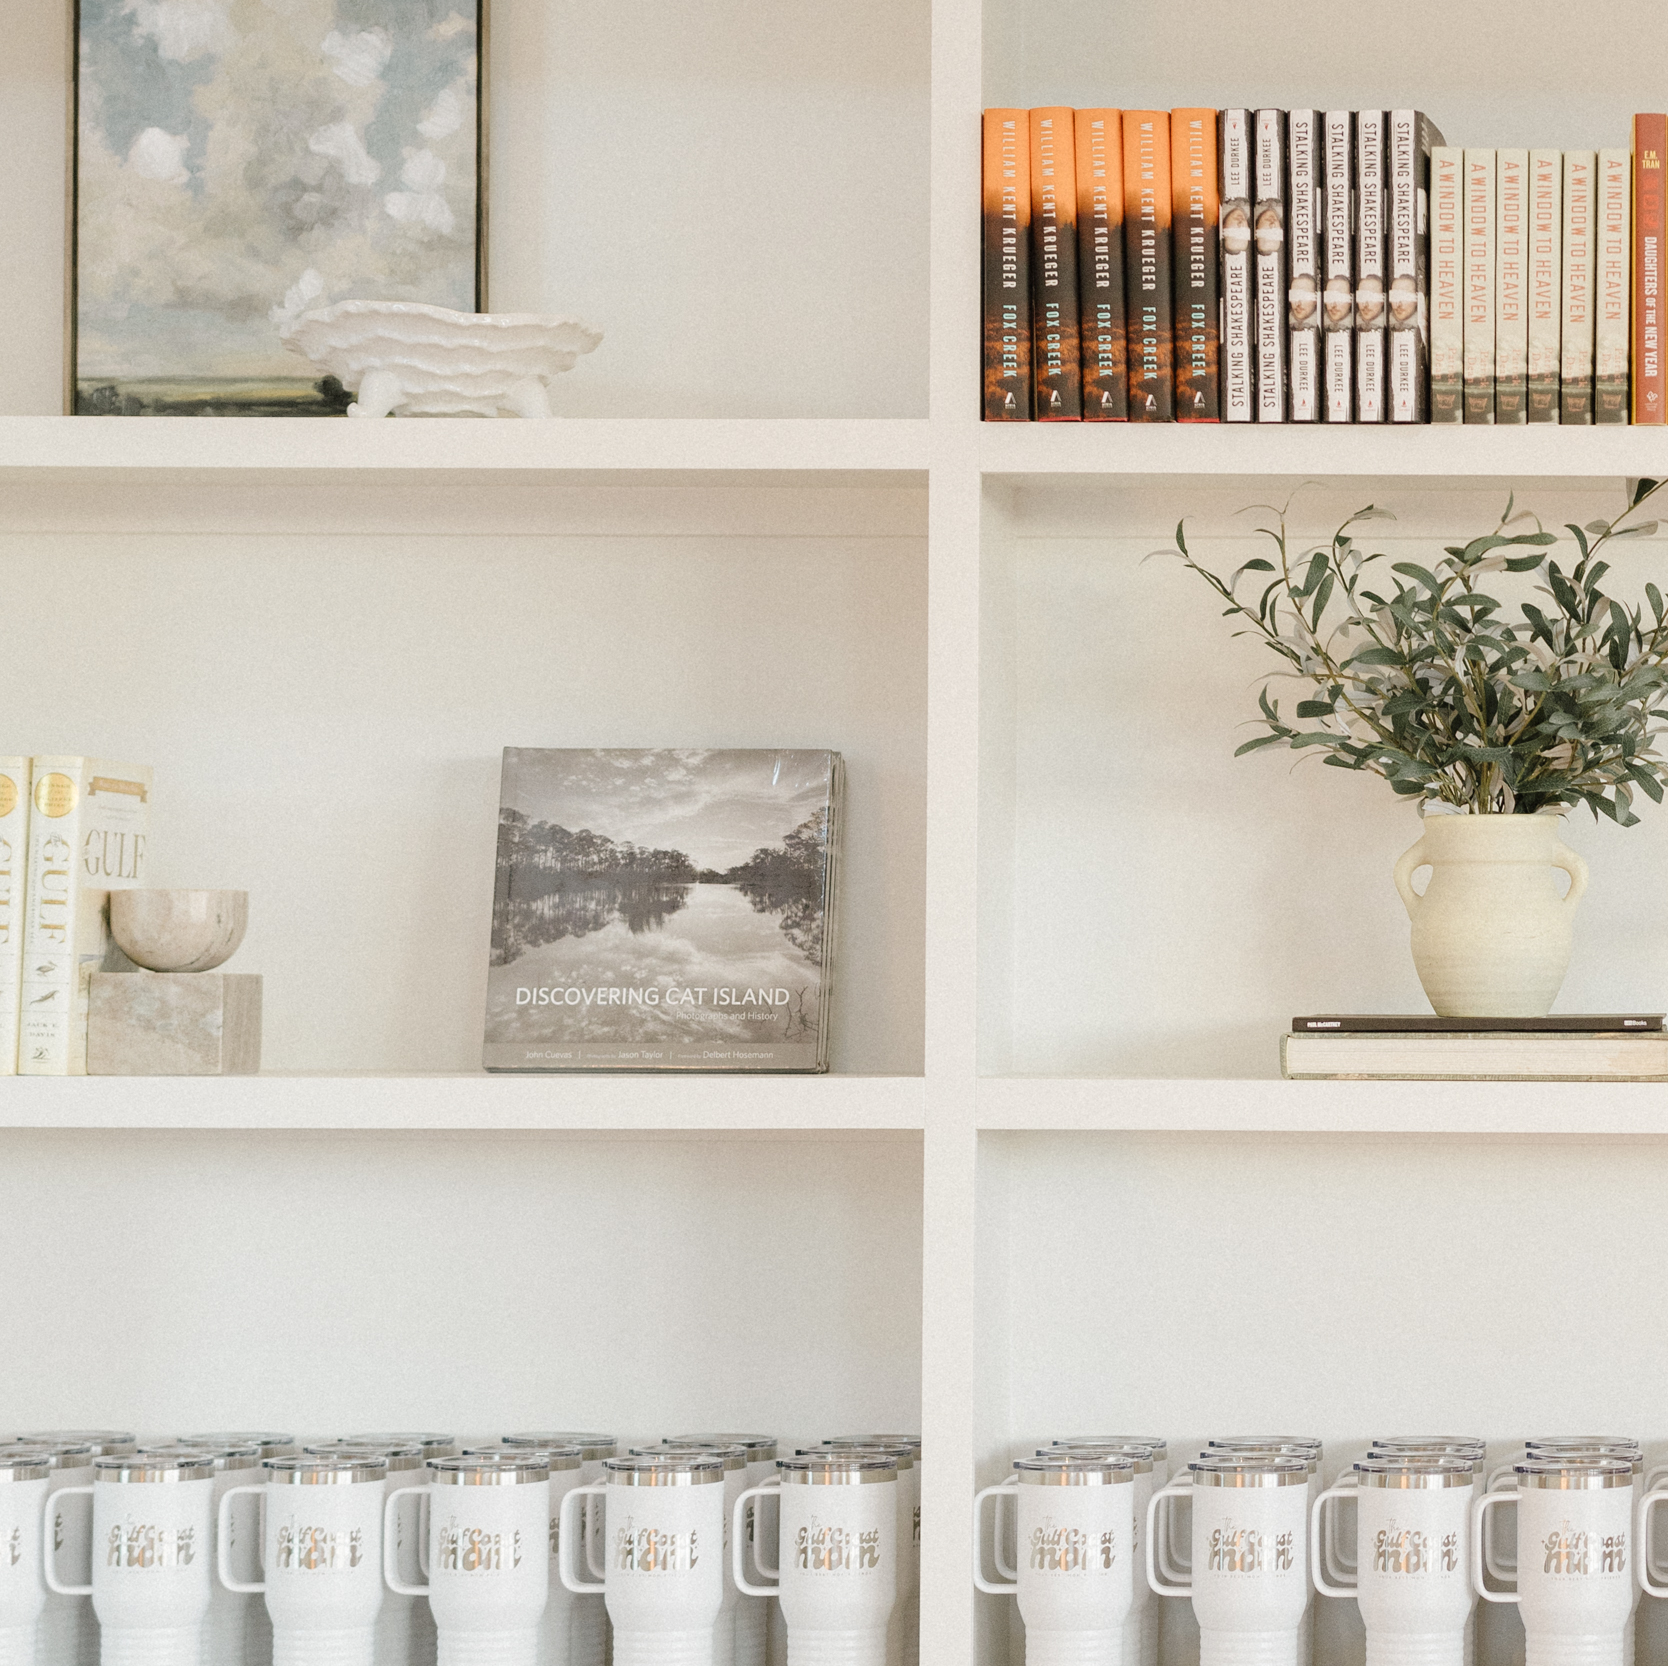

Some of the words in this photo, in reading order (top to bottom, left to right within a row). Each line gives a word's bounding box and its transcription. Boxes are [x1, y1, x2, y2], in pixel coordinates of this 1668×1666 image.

[1002, 120, 1015, 177] WILLIAM
[1295, 121, 1308, 177] STALKING
[1644, 150, 1657, 159] E.M.
[1439, 160, 1454, 169] A
[1642, 159, 1660, 169] TRAN
[1003, 186, 1016, 220] KENT
[1439, 173, 1455, 232] WINDOW
[1296, 183, 1309, 264] SHAKESPEARE
[1002, 227, 1016, 288] KRUEGER
[1438, 238, 1454, 254] TO
[1644, 237, 1657, 296] DAUGHTERS
[1438, 259, 1454, 320] HEAVEN
[1645, 298, 1655, 307] OF
[1003, 305, 1017, 329] FOX
[1645, 308, 1656, 325] THE
[1645, 327, 1657, 353] NEW
[1003, 336, 1017, 377] CREEK
[1644, 355, 1657, 377] YEAR
[516, 988, 659, 1005] DISCOVERING
[665, 987, 708, 1005] CAT
[713, 988, 790, 1005] ISLAND
[676, 1011, 728, 1022] Photographs
[729, 1012, 746, 1020] and
[748, 1011, 778, 1022] History
